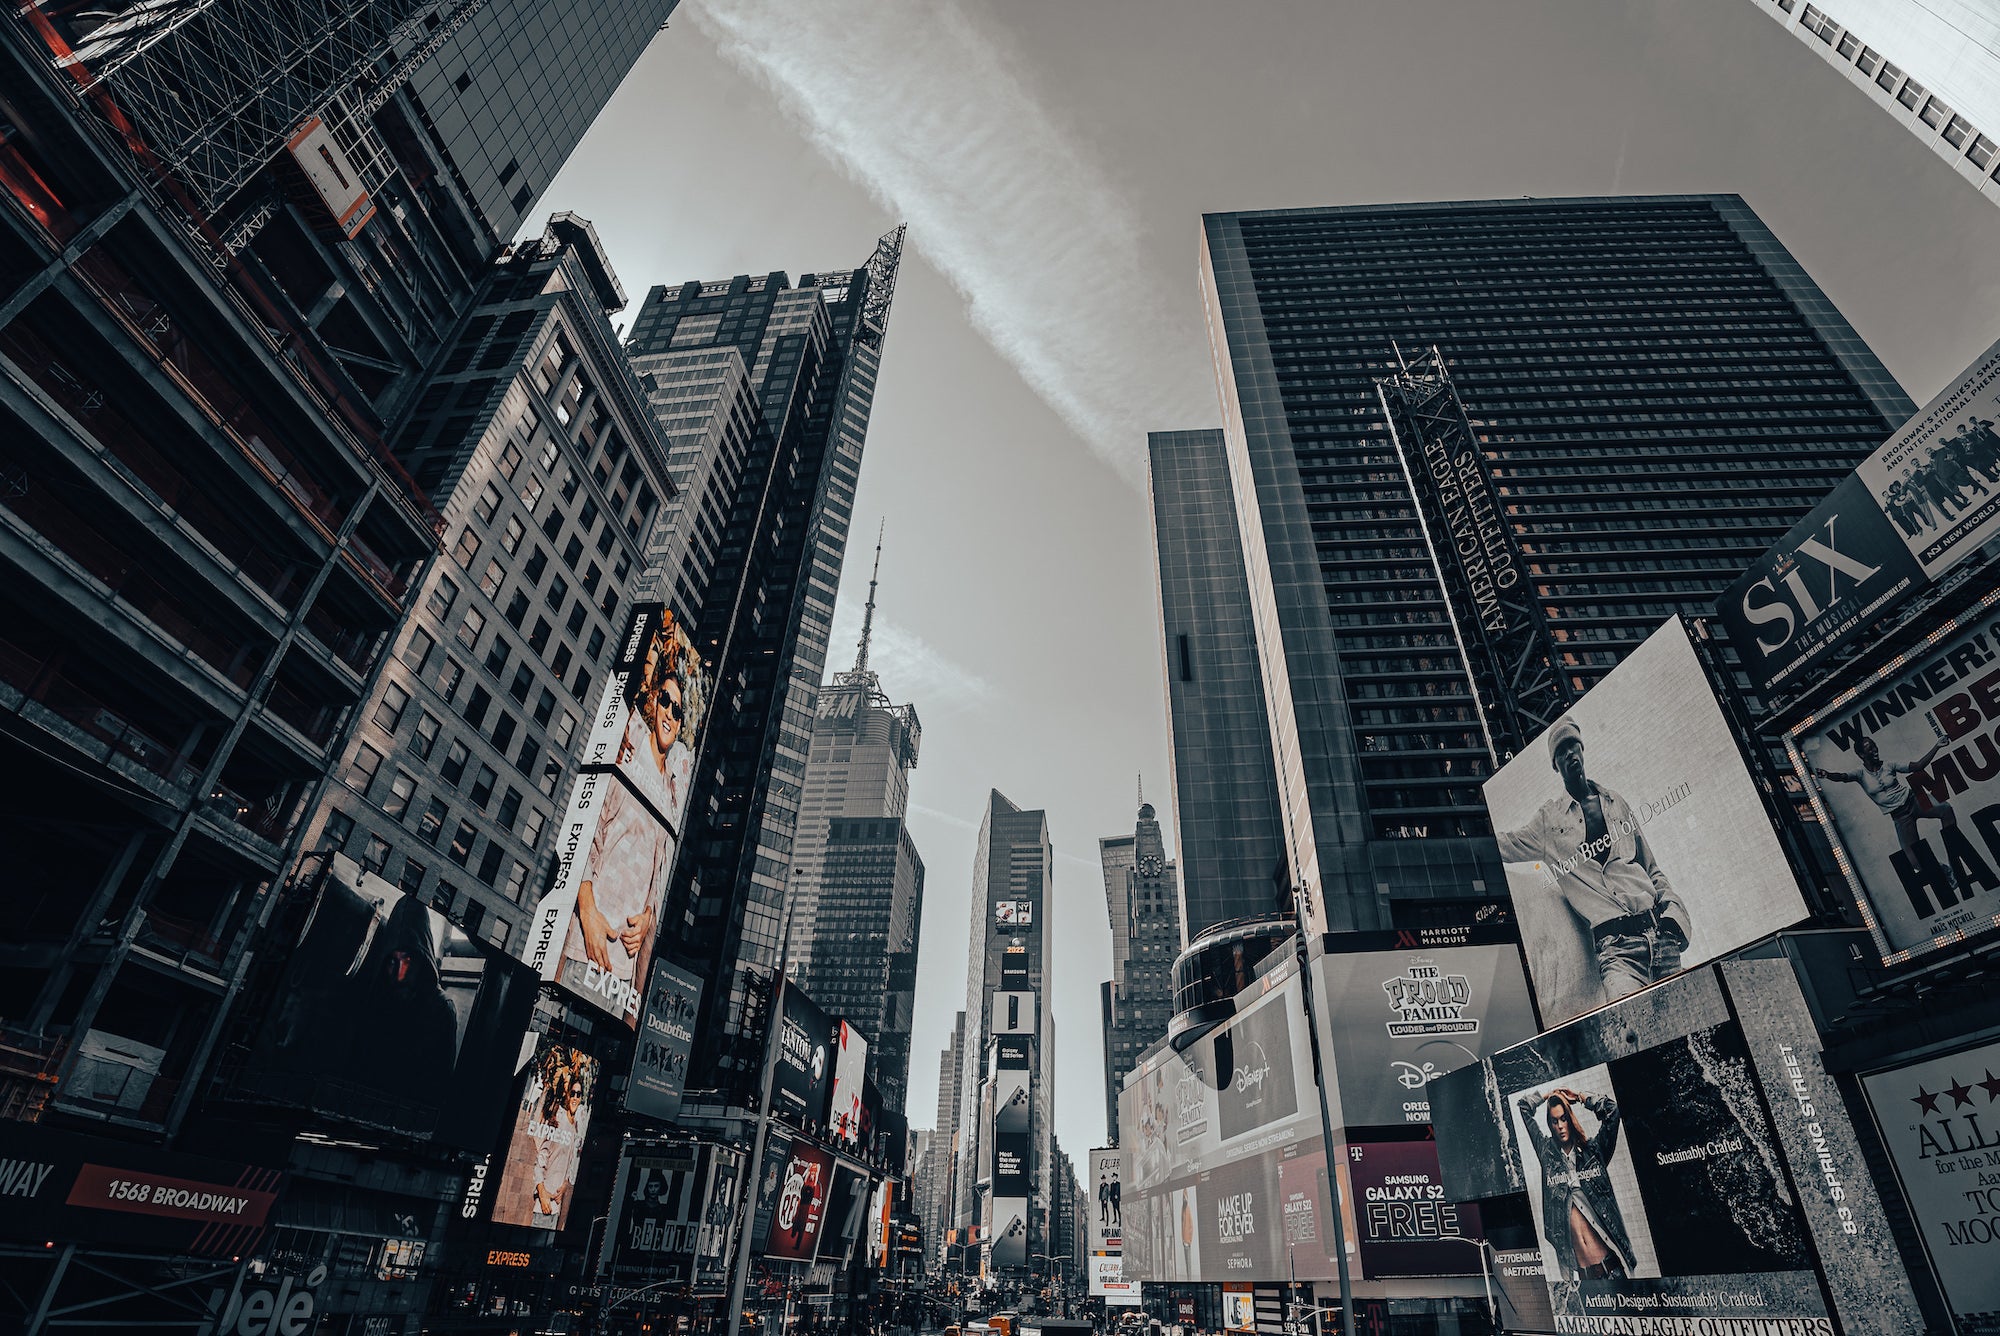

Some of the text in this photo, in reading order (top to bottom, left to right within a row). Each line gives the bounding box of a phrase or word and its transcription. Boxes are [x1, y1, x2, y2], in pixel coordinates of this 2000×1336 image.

[1881, 416, 1934, 463] BROADWAY'S
[1933, 377, 1976, 417] FUNNIEST
[1886, 455, 1904, 472] AND
[1903, 397, 1971, 456] INTERNATIONAL
[1424, 437, 1508, 632] AMERICAN EAGLE
[1454, 450, 1518, 589] OUTFITTERS
[1942, 527, 1963, 546] NEW
[1963, 503, 1996, 530] WORLD
[1742, 514, 1882, 658] SIX
[623, 613, 649, 663] EXPRESS
[1794, 595, 1864, 652] THE MUSICAL
[602, 671, 630, 728] EXPRESS
[1825, 633, 1996, 753] WINNER!
[1552, 852, 1580, 877] New
[1579, 816, 1623, 863] Breed
[1621, 813, 1638, 836] of
[1640, 778, 1693, 826] Denim
[554, 823, 584, 890] EXPRESS
[1420, 926, 1471, 937] MARRIOTT
[1422, 935, 1468, 945] MARQUIS
[1007, 946, 1025, 954] 2022
[1409, 967, 1438, 979] THE
[1384, 976, 1471, 1009] PROUD
[647, 1012, 692, 1042] Doubtfire
[1392, 1023, 1426, 1035] LOUDER
[1437, 1022, 1475, 1033] PROUDER
[1401, 1006, 1462, 1022] FAMILY
[1779, 1044, 1816, 1118] STREET
[527, 1120, 572, 1146] EXPRESS
[1656, 1136, 1744, 1167] Sustainably Crafted
[1808, 1122, 1846, 1202] SPRING
[1935, 1159, 1958, 1175] for
[1958, 1155, 1984, 1171] the
[1365, 1185, 1424, 1201] GALAXY
[1384, 1174, 1430, 1185] SAMSUNG
[108, 1179, 249, 1215] 1568 BROADWAY
[1218, 1192, 1253, 1218] MAKE UP
[1284, 1199, 1312, 1214] GALAXY S22
[1219, 1213, 1255, 1237] FOR EVER
[1285, 1210, 1316, 1241] FREE
[1366, 1201, 1461, 1238] FREE
[486, 1250, 532, 1268] EXPRESS
[1227, 1258, 1253, 1269] SEPHORA
[1585, 1293, 1618, 1310] Artfully
[1660, 1291, 1718, 1311] Sustainably
[1556, 1316, 1834, 1336] AMERICAN EAGLE OUTFITTERS
